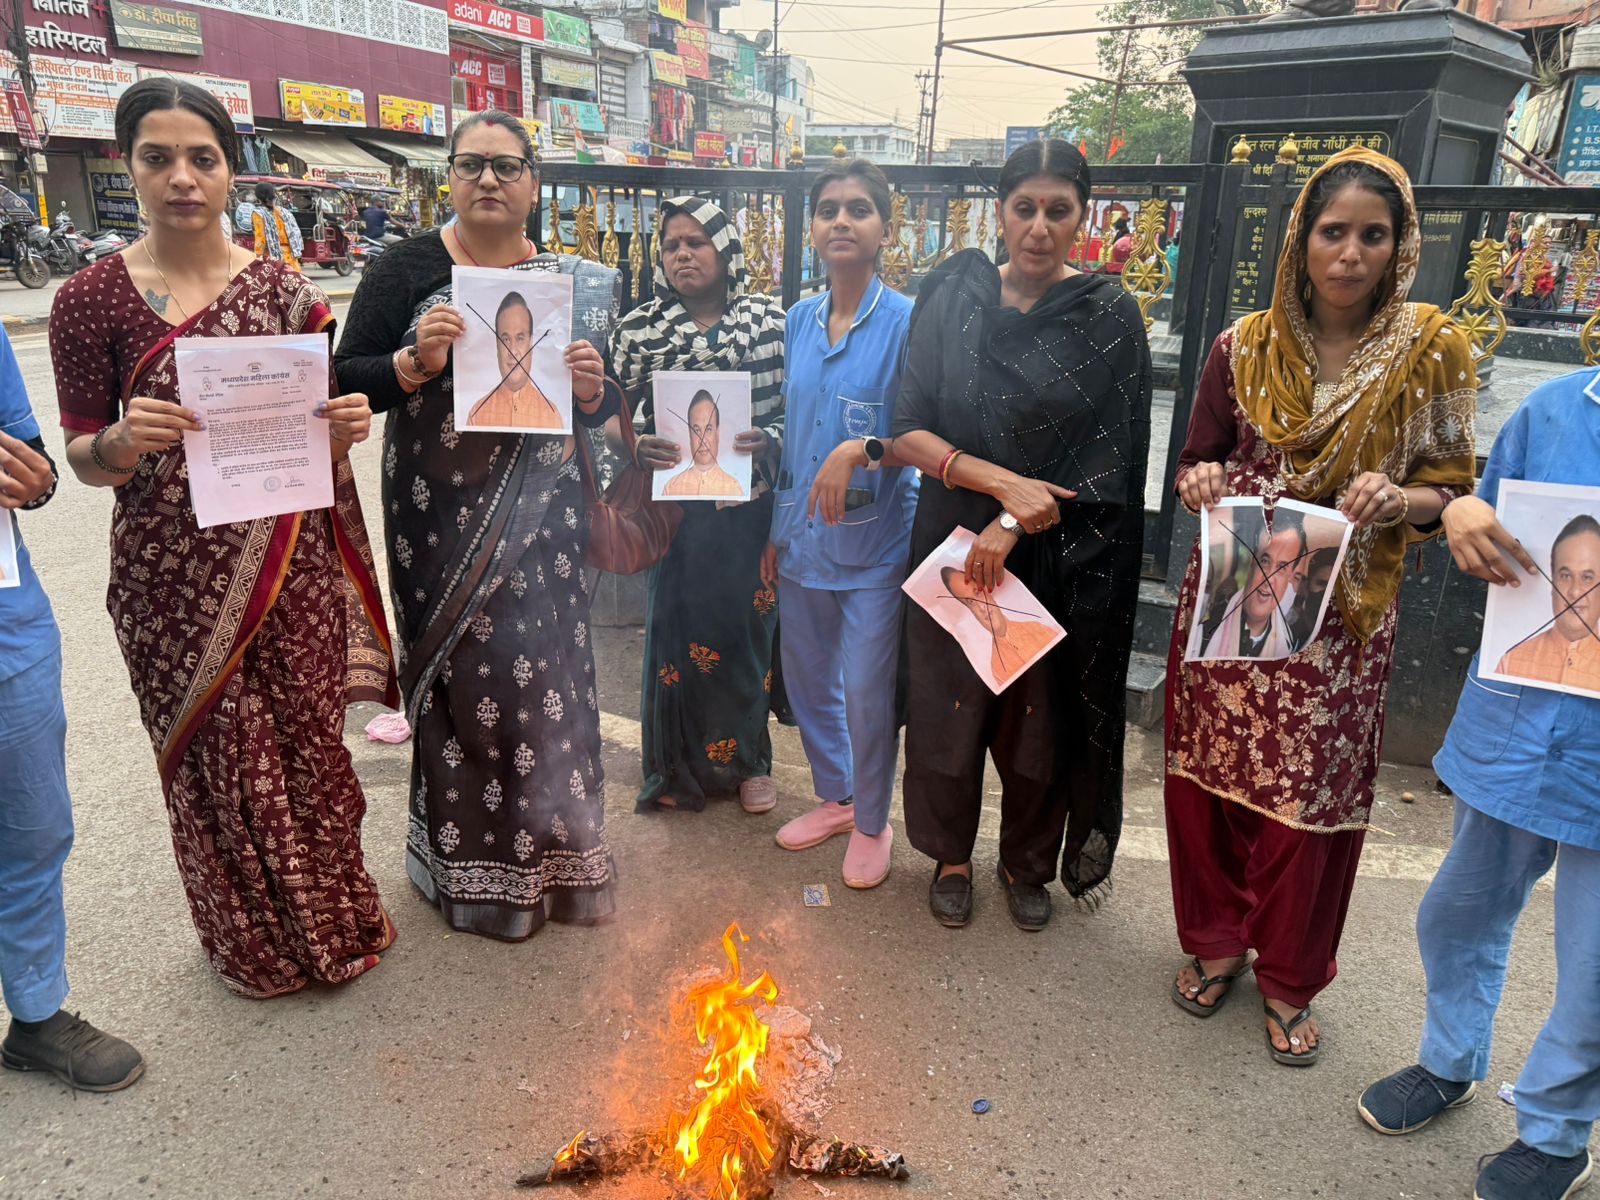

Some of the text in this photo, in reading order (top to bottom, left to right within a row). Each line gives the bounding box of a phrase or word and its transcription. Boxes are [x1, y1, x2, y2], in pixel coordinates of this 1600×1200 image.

[454, 2, 512, 30] adani ACC
[25, 21, 107, 56] हास्पिटल
[460, 59, 482, 77] ACC
[1367, 135, 1383, 150] की
[250, 373, 271, 382] महिला
